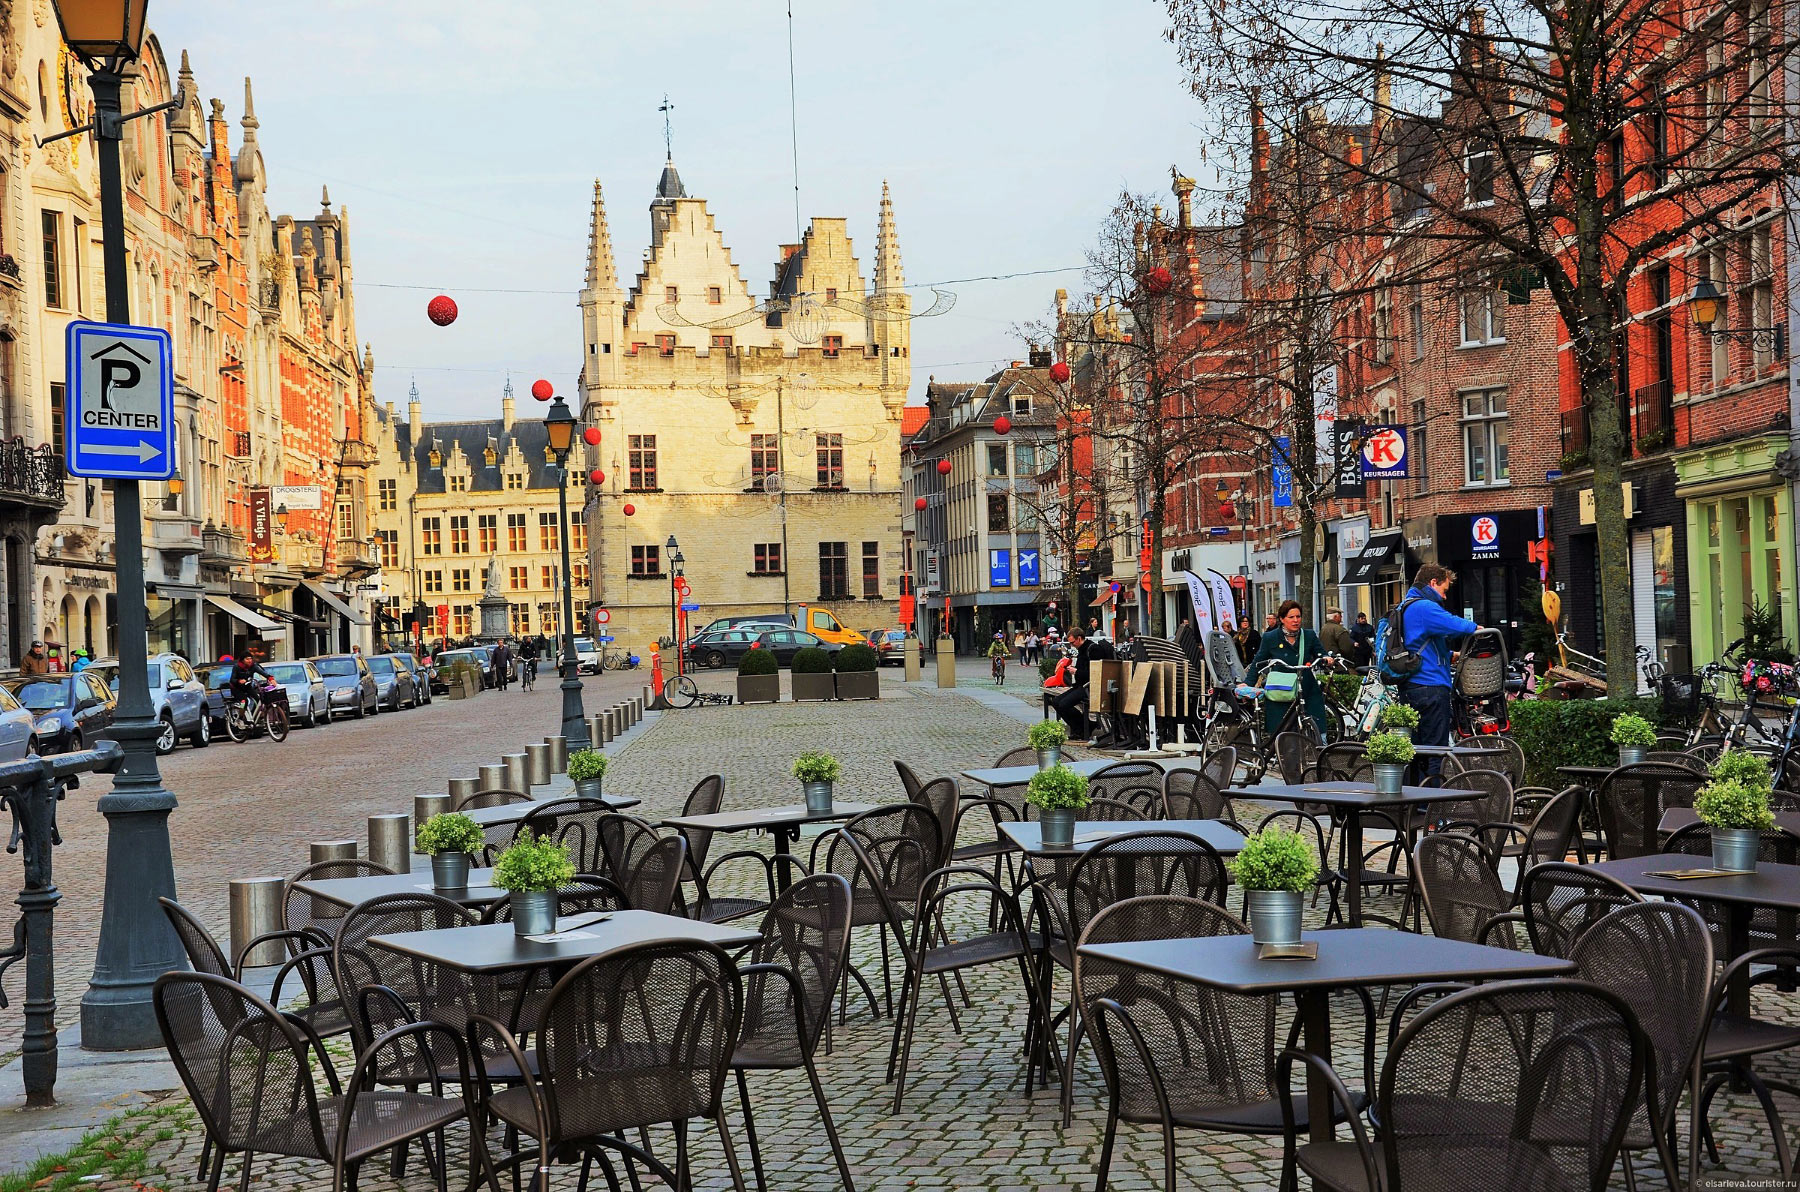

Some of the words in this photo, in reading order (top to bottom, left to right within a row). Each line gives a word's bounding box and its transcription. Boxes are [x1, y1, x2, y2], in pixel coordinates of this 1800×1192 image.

[101, 358, 141, 410] P
[1324, 371, 1334, 407] Serve
[83, 410, 159, 429] CENTER
[1326, 426, 1335, 457] Cook
[1370, 439, 1398, 462] K
[1363, 470, 1406, 478] KEURSLAGER
[254, 506, 267, 539] Vlietje
[1476, 525, 1494, 541] K
[928, 557, 937, 574] ALIBI
[1471, 552, 1500, 560] ZAMAN
